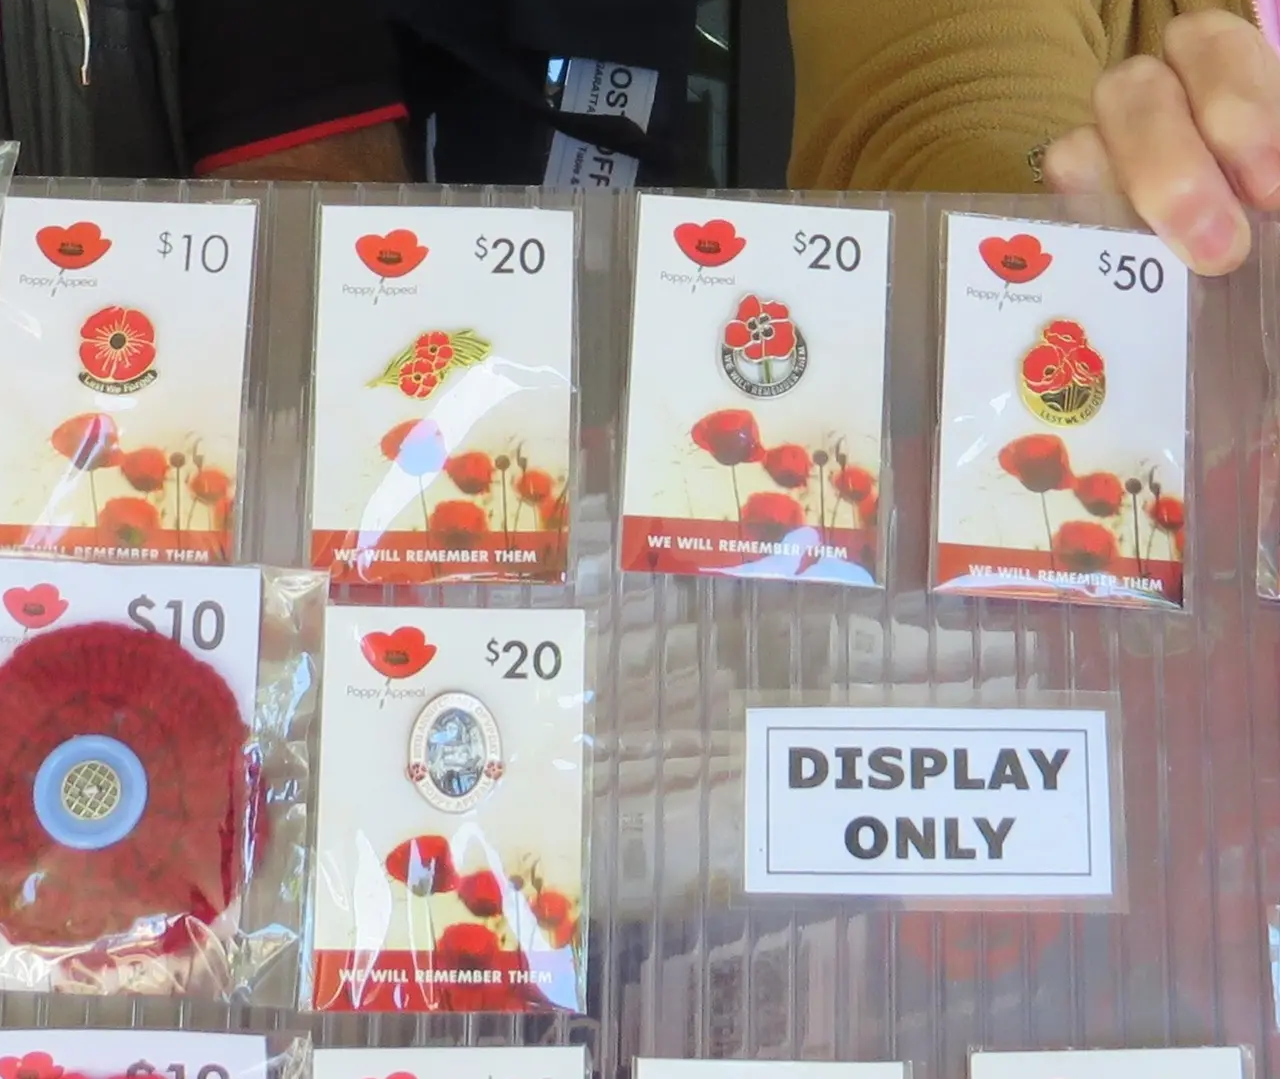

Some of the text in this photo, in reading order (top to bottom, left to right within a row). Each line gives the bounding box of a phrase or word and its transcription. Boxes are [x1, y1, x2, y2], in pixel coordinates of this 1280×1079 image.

[157, 231, 230, 274] $10
[474, 234, 546, 274] $20
[793, 230, 862, 272] $20
[19, 274, 98, 289] Poppy Appeal
[660, 270, 737, 287] Poppy Appeal
[1097, 250, 1165, 294] $50
[341, 282, 418, 299] Poppy Appeal
[966, 286, 1044, 304] Poppy Appeal
[74, 546, 159, 561] REMEMBER
[167, 549, 209, 562] THEM
[334, 549, 537, 564] WE WILL REMEMBER THEM
[647, 535, 848, 560] WE WILL REMEMBER THEM
[969, 564, 1164, 593] WE WILL REMEMBER THEM
[127, 593, 226, 651] $10
[484, 638, 562, 681] $20
[346, 684, 426, 700] Poppy Appeal
[787, 746, 1070, 791] DISPLAY
[843, 815, 1018, 861] ONLY
[340, 970, 553, 985] WE WILL REMEMBER THEM
